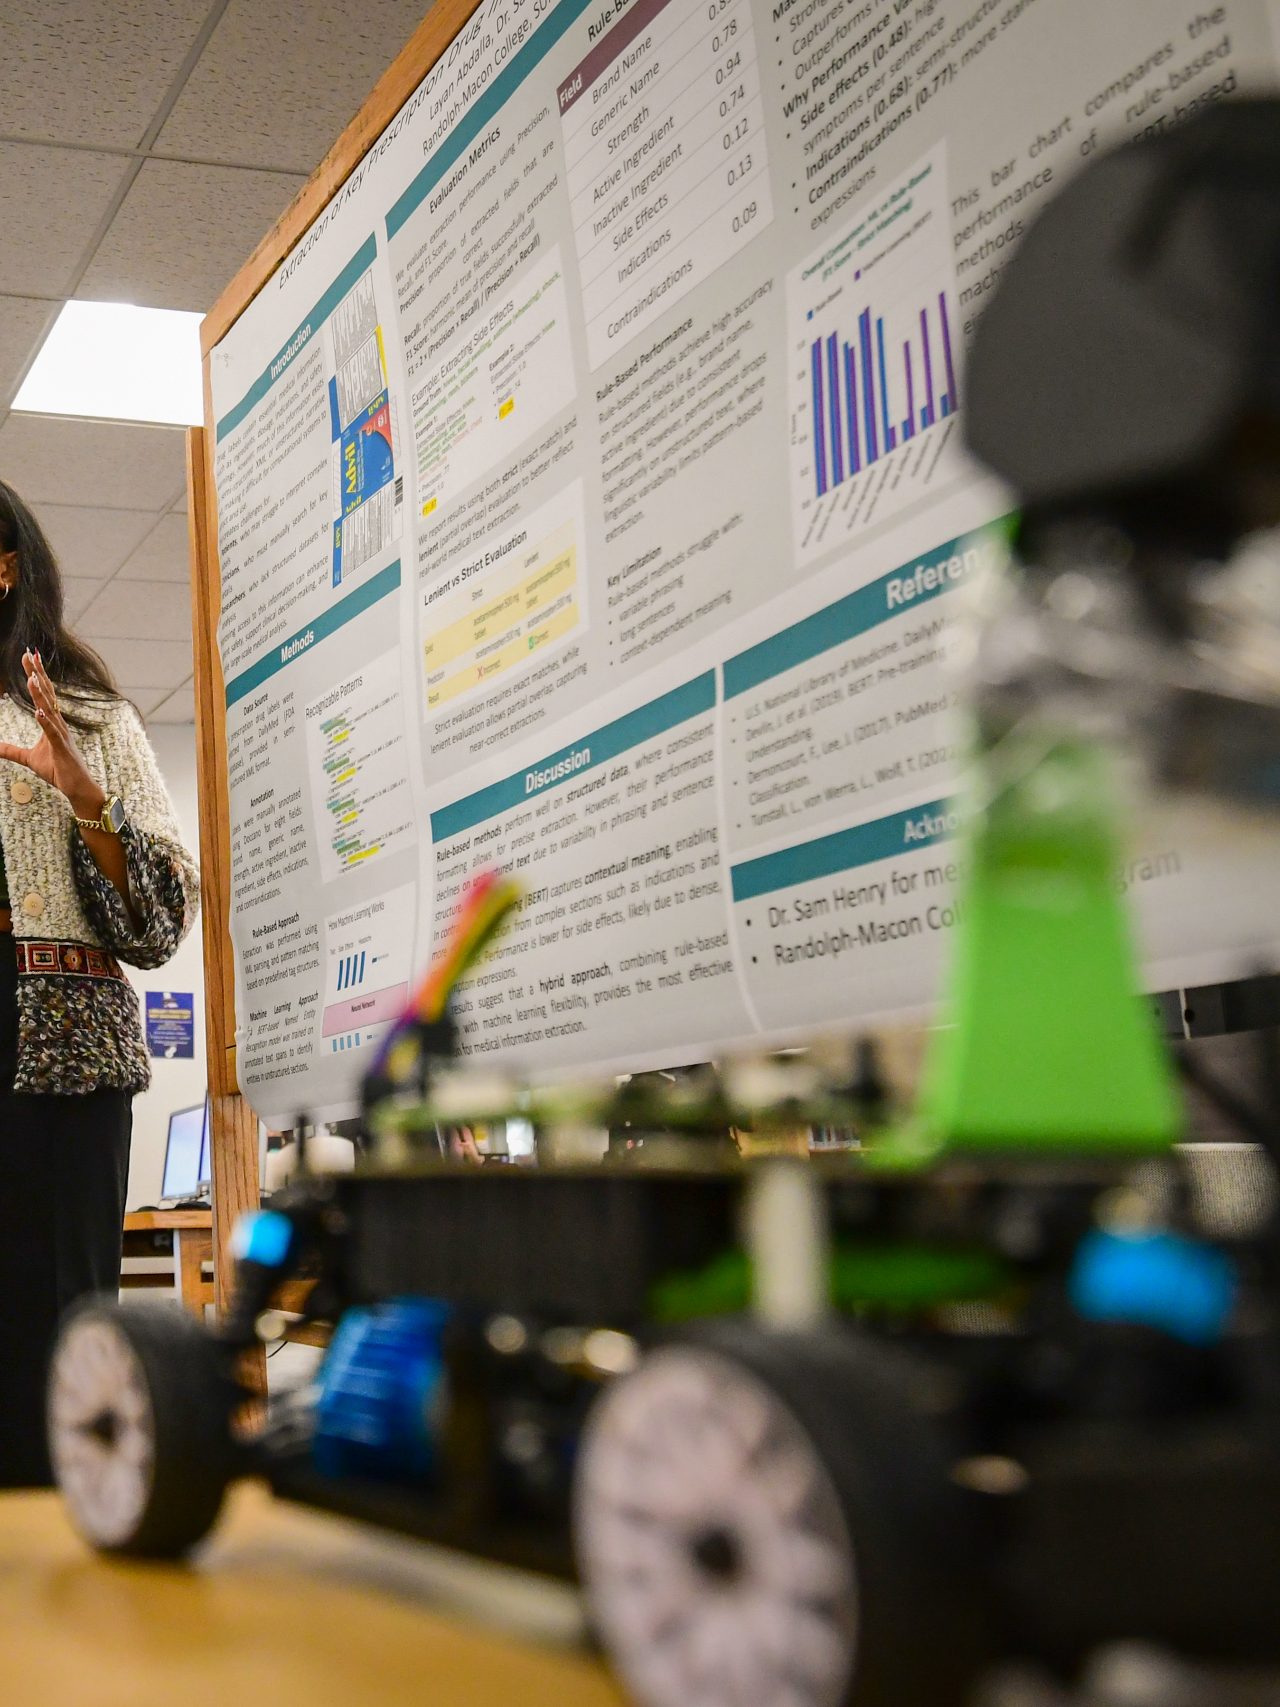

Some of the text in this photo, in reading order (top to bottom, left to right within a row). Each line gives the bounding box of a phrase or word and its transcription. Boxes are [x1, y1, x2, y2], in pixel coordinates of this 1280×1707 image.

[712, 19, 738, 53] 0.78
[792, 2, 844, 56] Captures
[795, 4, 872, 80] Outperforms
[423, 20, 532, 155] Randolph-Macon College,
[430, 10, 510, 120] Layan Abdalla, Dr.
[559, 73, 583, 108] Field
[591, 61, 660, 137] Generic Name
[592, 36, 652, 104] Brand Name
[715, 51, 741, 85] 0.94
[783, 88, 809, 119] Why
[812, 13, 890, 93] Performance
[800, 99, 825, 130] Side
[829, 61, 869, 105] effects
[872, 19, 912, 68] (0.48):
[804, 94, 863, 156] symptoms
[866, 72, 886, 105] per
[889, 17, 945, 77] sentence
[607, 106, 650, 155] Strength
[719, 84, 745, 118] 0.74
[722, 118, 749, 151] 0.12
[806, 76, 912, 180] Indications (0.68):
[808, 104, 912, 204] Contraindications
[916, 62, 958, 112] (0.77):
[961, 27, 997, 67] more
[951, 187, 981, 217] This
[990, 158, 1017, 189] bar
[1028, 115, 1073, 159] chart
[1084, 42, 1174, 118] compares
[1187, 7, 1227, 41] the
[280, 16, 483, 290] Extraction of Key Prescription Drug
[430, 127, 500, 214] Evaluation Metrics
[593, 116, 675, 204] Active Ingredient
[727, 154, 753, 187] 0.13
[954, 165, 1053, 251] performance
[1080, 128, 1097, 157] of
[1125, 34, 1231, 124] rule-based
[395, 107, 550, 283] We evaluate extraction performance using Precision,
[593, 143, 683, 237] Inactive Ingredient
[613, 193, 669, 252] Side Effects
[732, 201, 757, 233] 0.09
[810, 165, 876, 231] expressions
[400, 141, 554, 314] Precision: proportion of extracted fields that are
[404, 174, 558, 346] Recall: proportion of true fields successfully extracted
[463, 237, 483, 264] correct
[618, 228, 671, 284] Indications
[956, 218, 1024, 277] methods
[607, 259, 694, 339] Contraindications
[271, 324, 311, 380] Introduction
[411, 371, 440, 406] Example:
[440, 338, 474, 378] Extracting
[474, 325, 489, 349] Side
[489, 300, 514, 333] Effects
[596, 317, 693, 402] Rule-Based Performance
[345, 441, 357, 493] Advil
[418, 415, 577, 546] We report results using both strict (exact match) and
[424, 530, 527, 606] Lenient vs Strict Evaluation
[886, 549, 979, 610] Referen
[281, 630, 315, 663] Methods
[305, 676, 363, 720] Recognizable Patterns
[250, 788, 275, 808] Annotation
[436, 838, 470, 863] Rule-based
[473, 826, 502, 848] methods
[505, 812, 532, 834] perform
[535, 801, 550, 818] well
[554, 798, 563, 809] on
[566, 772, 606, 803] structured
[610, 765, 630, 783] data,
[635, 749, 663, 770] where
[525, 748, 591, 794] Discussion
[525, 826, 718, 910] (BERT) captures contextual meaning, enabling
[768, 905, 790, 929] Dr.
[793, 894, 830, 923] Sam
[833, 880, 886, 913] Henry
[891, 868, 918, 896] for
[252, 912, 300, 939] Rule-Based Approach
[328, 901, 385, 931] How Machine Learning Works
[773, 914, 922, 967] Randolph-Macon
[249, 992, 319, 1022] Machine Learning Approach
[452, 928, 729, 1015] results suggest that a hybrid approach, combining rule-based
[463, 960, 734, 1034] with machine learning flexibility, provides the most effective
